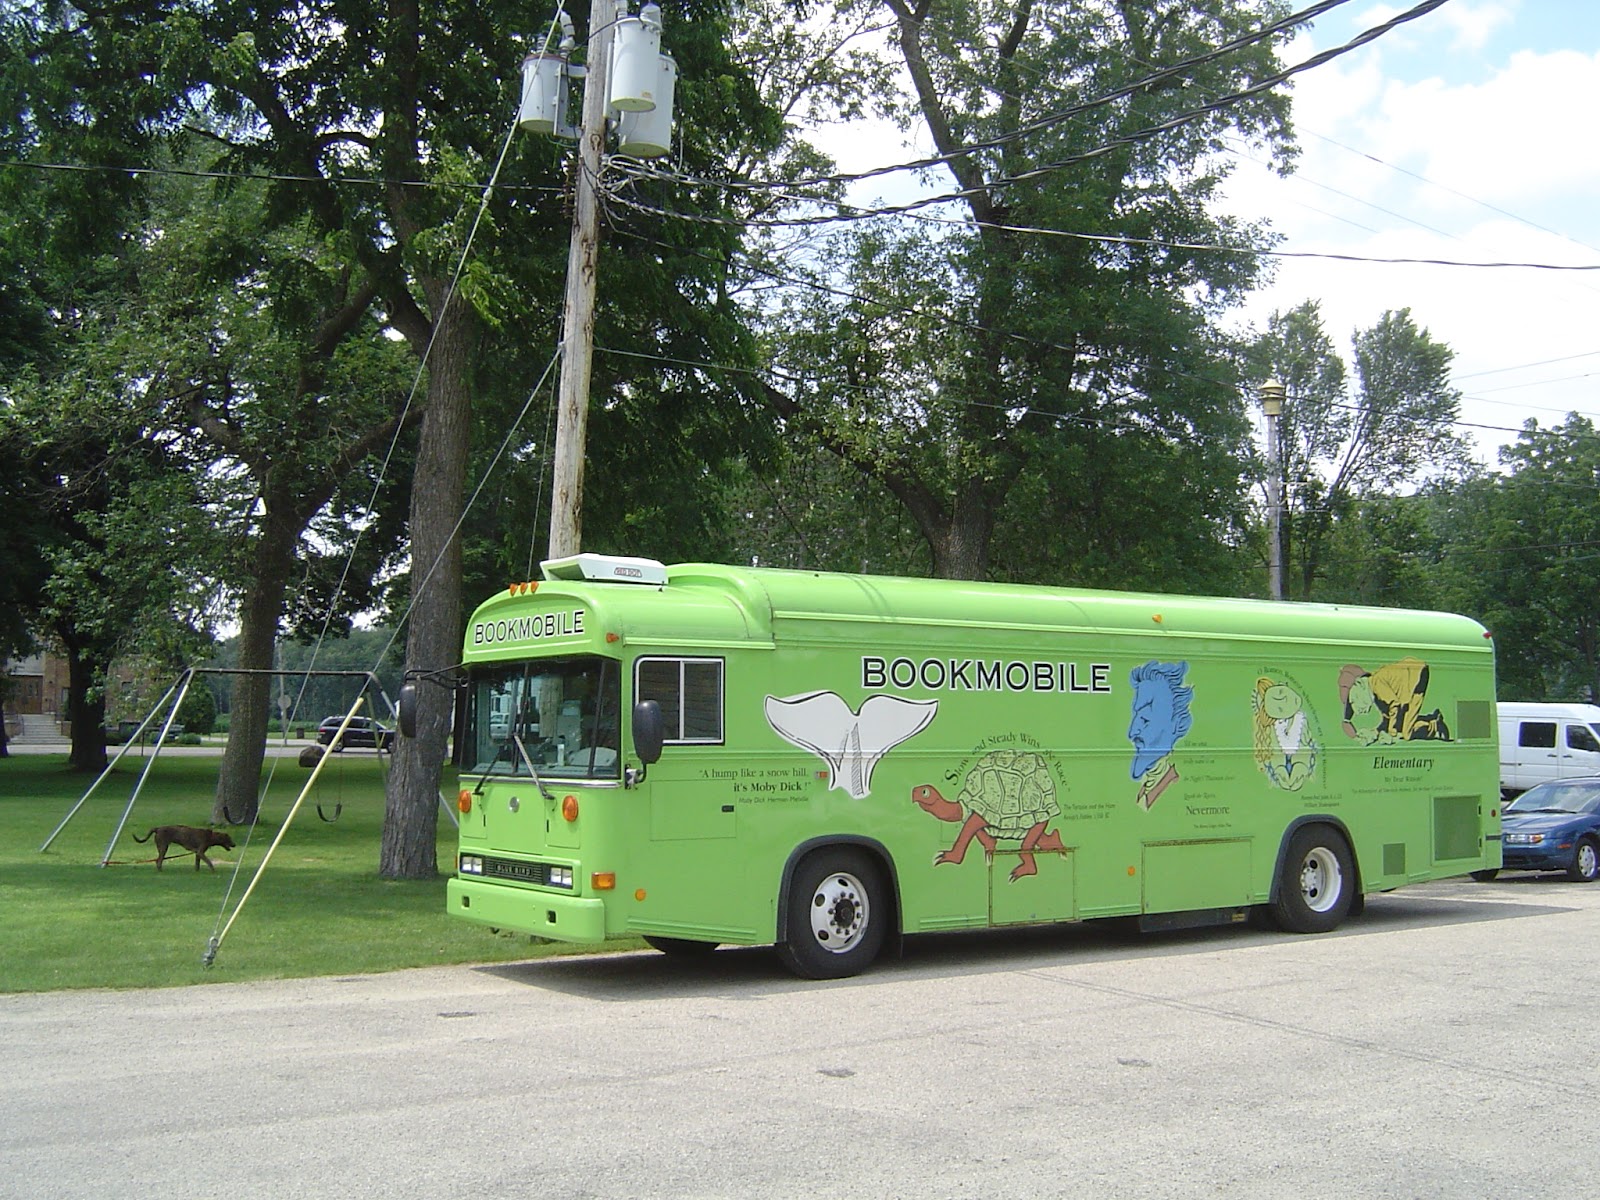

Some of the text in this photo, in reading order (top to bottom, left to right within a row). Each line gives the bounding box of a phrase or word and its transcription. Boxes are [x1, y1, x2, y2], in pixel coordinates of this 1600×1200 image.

[474, 610, 585, 645] BOOKMOBILE
[862, 657, 1111, 692] BOOKMOBILE
[988, 732, 1017, 745] Steady
[1020, 733, 1041, 748] Wins
[1373, 756, 1435, 772] Elementary
[712, 769, 738, 780] hump
[741, 768, 757, 777] like
[734, 782, 748, 792] it's
[751, 782, 777, 793] Moby
[780, 782, 803, 792] Dick
[1186, 805, 1230, 815] Nevermore
